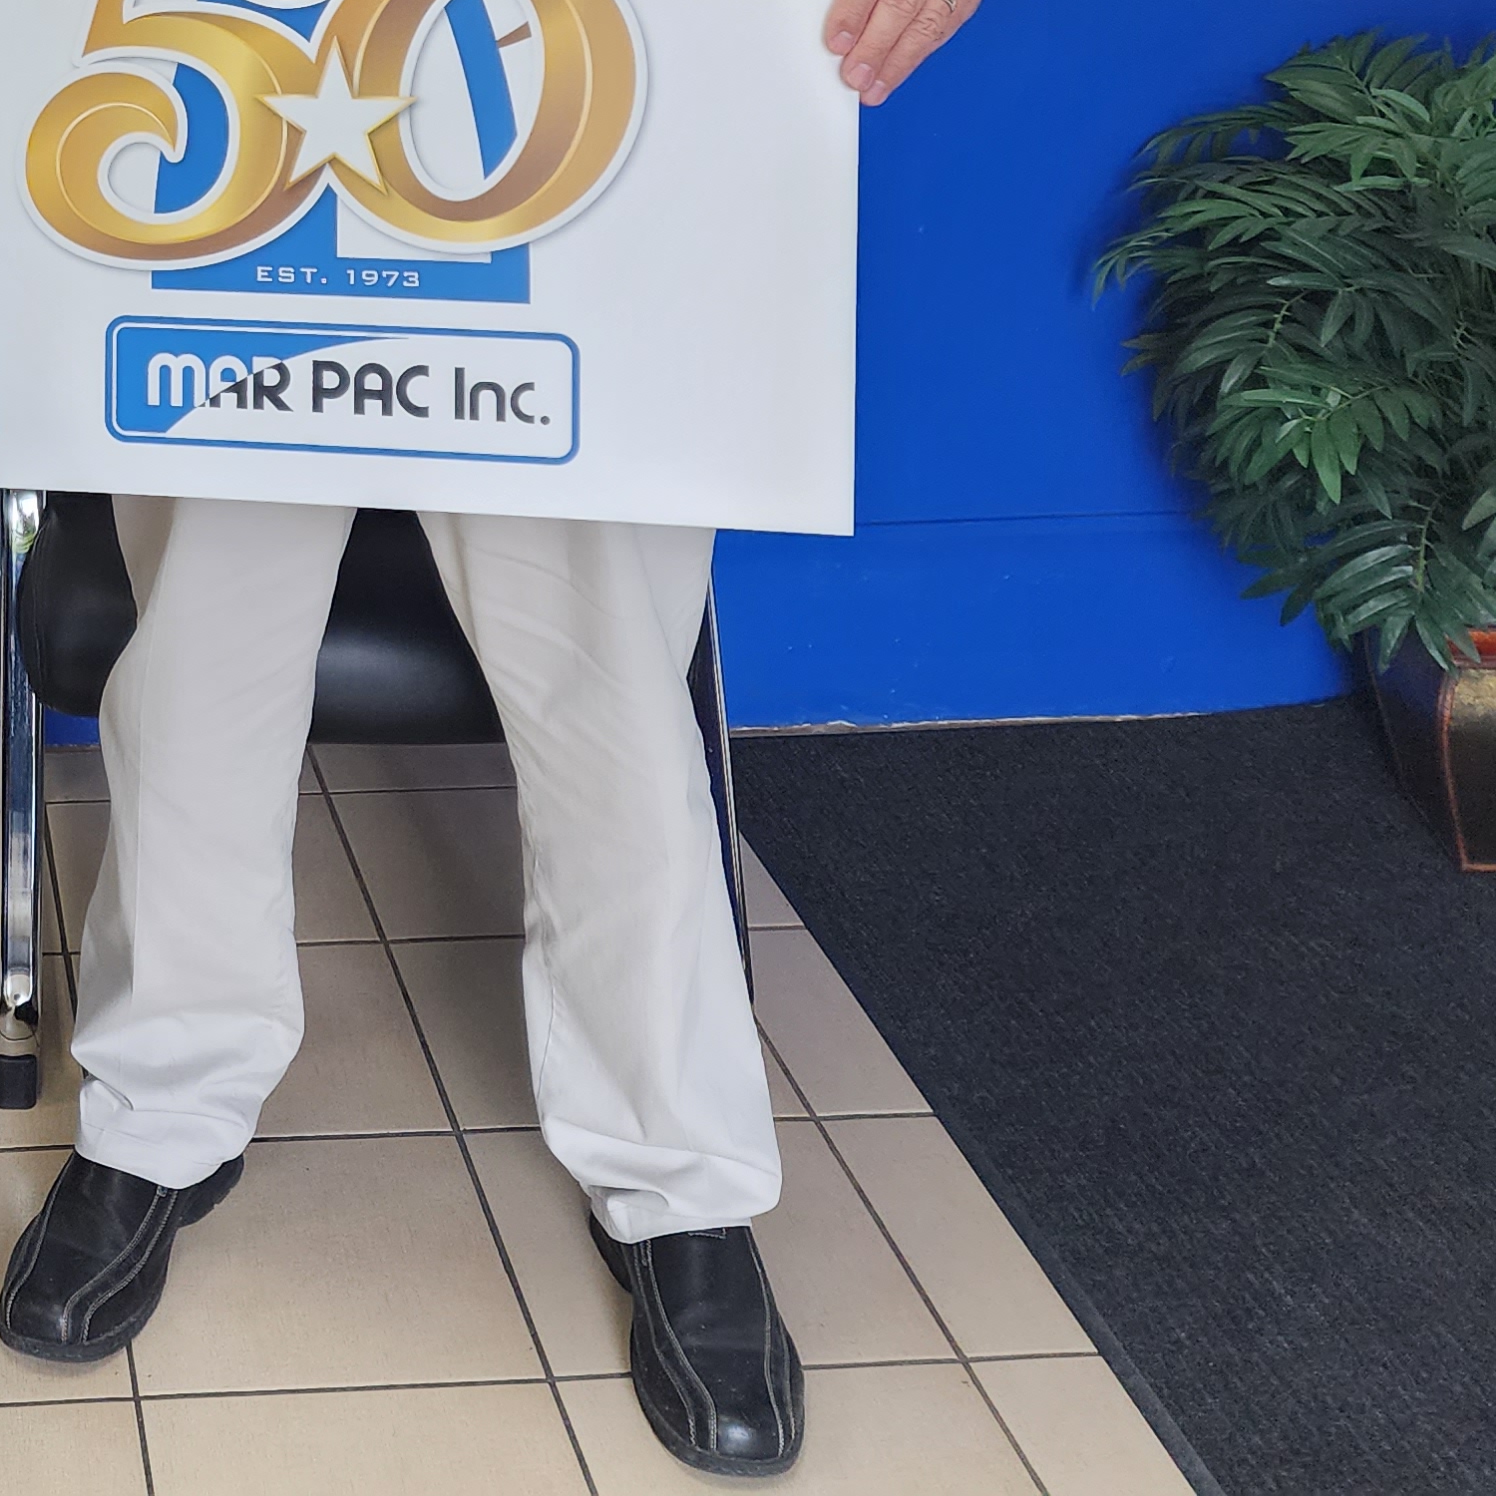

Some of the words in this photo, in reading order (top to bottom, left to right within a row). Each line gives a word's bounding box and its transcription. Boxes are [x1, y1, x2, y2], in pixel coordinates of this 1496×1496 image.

[256, 265, 328, 286] EST.
[346, 267, 421, 289] 1973
[147, 351, 294, 413] MAR
[311, 358, 430, 419] PAC
[453, 365, 551, 426] Inc.
